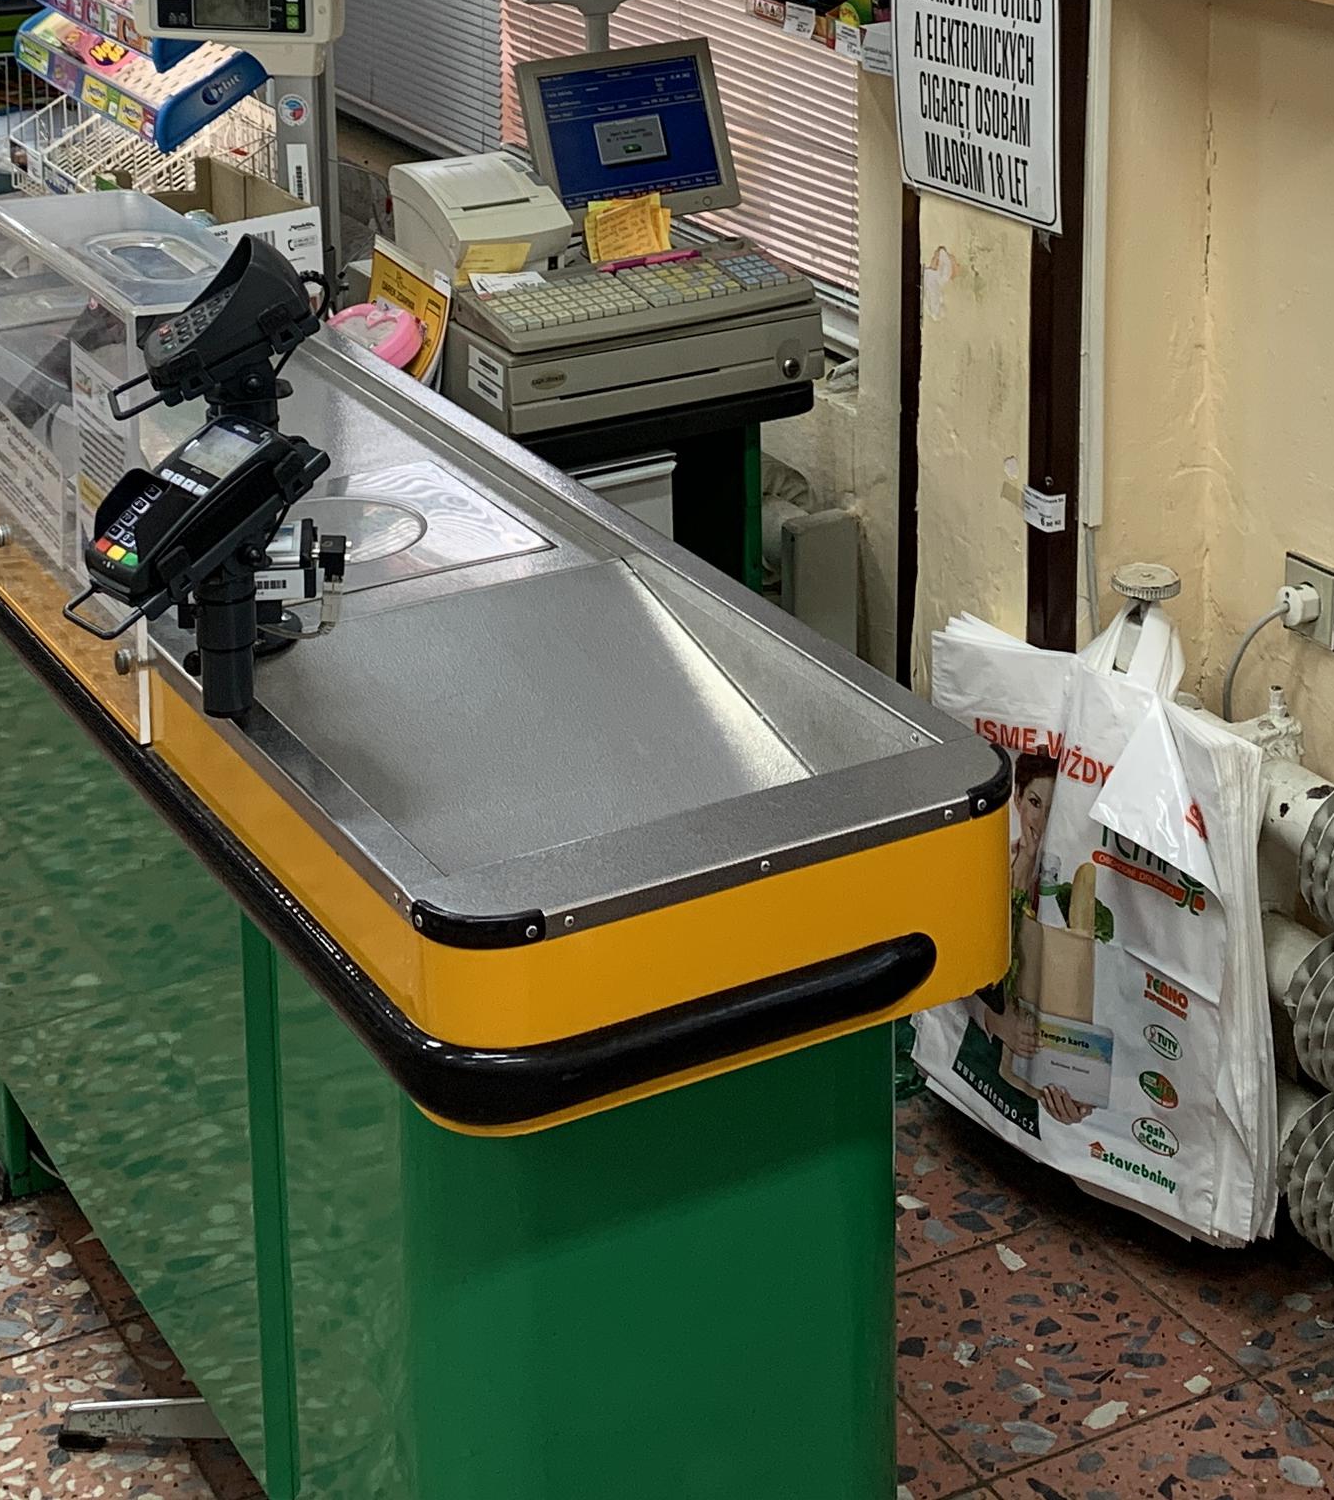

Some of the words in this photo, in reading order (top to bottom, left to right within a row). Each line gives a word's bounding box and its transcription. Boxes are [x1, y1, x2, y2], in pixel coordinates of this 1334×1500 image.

[913, 11, 924, 59] A
[926, 13, 1036, 87] ELEKTRONICKÝCH
[919, 69, 972, 136] CIGARET
[974, 83, 1032, 149] OSOBÁM
[924, 126, 986, 195] MLADŠÍM
[987, 149, 1005, 193] 18
[1008, 155, 1030, 209] LET
[1144, 971, 1189, 1010] TERNO
[1039, 1028, 1068, 1045] Tempo
[1067, 1035, 1091, 1050] karta
[954, 1058, 1036, 1133] www.odtempo.cz
[1139, 1119, 1166, 1140] Cash
[1145, 1131, 1176, 1159] Carry
[1100, 1149, 1178, 1195] stavebniny
